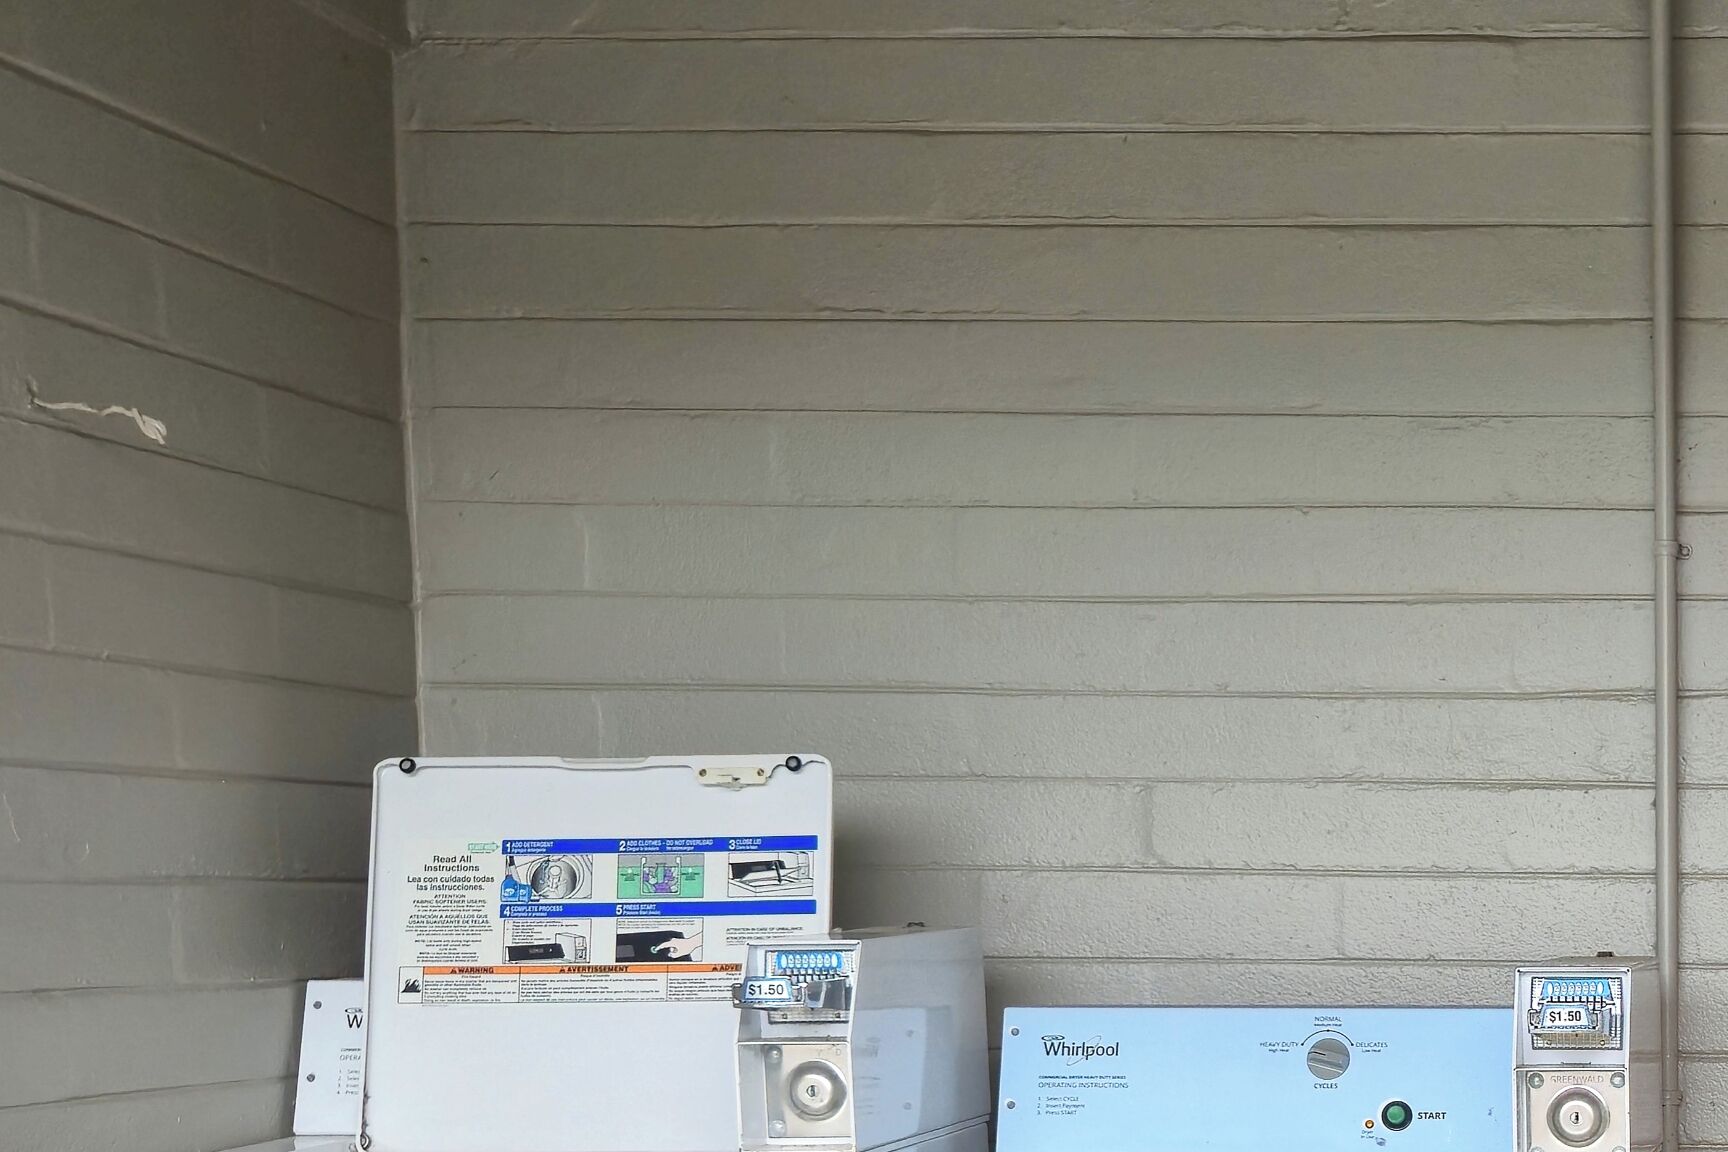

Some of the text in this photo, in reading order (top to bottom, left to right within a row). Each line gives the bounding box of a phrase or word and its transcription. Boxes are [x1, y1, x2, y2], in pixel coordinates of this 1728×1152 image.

[619, 840, 627, 851] 2
[729, 839, 736, 850] 3
[433, 855, 472, 864] Read All
[424, 864, 480, 872] Instructions
[503, 905, 511, 916] 4
[615, 904, 623, 915] 5
[748, 983, 784, 996] $1.50
[1549, 1010, 1582, 1023] $1.50
[1043, 1041, 1120, 1061] Whirlpool
[1550, 1075, 1604, 1084] GREENWALD
[1416, 1111, 1447, 1120] START
